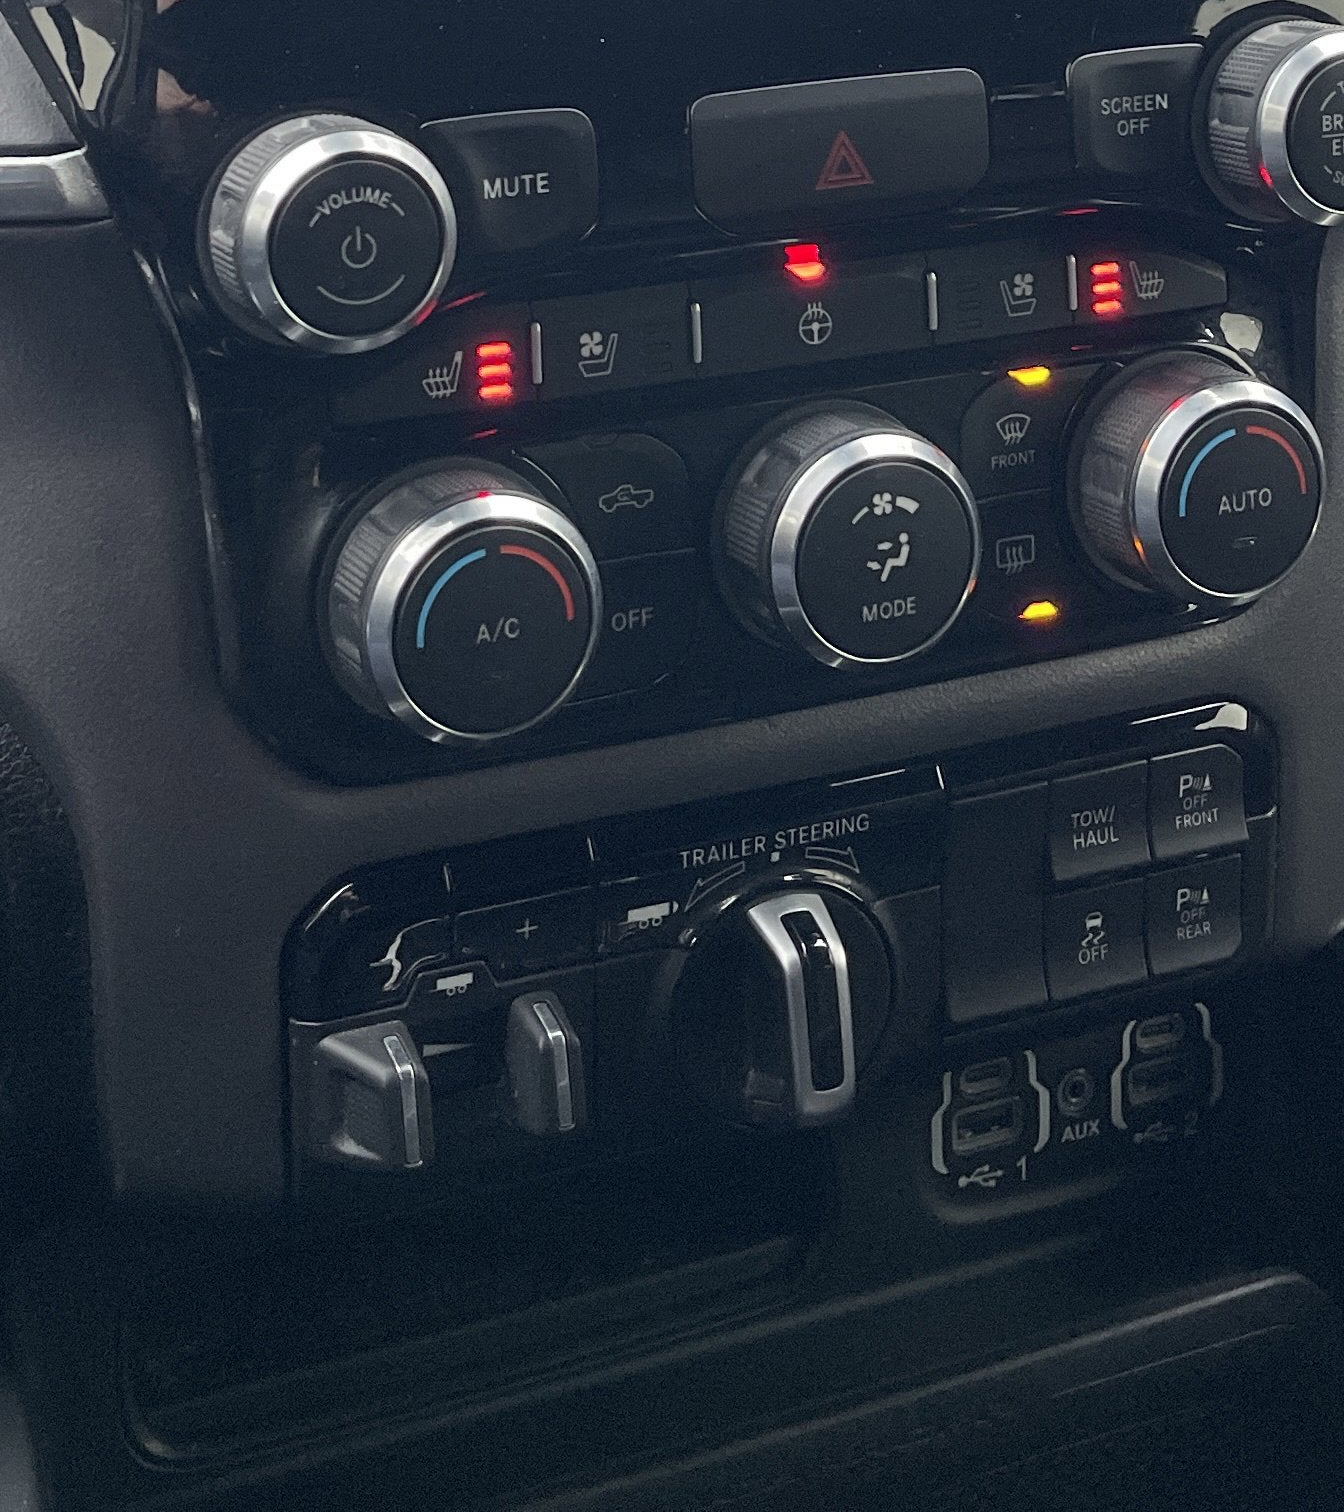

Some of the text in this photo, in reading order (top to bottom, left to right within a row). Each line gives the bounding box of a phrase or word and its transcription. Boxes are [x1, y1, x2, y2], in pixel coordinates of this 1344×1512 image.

[1100, 93, 1169, 117] SCREEN
[1116, 117, 1151, 138] OFF
[483, 172, 551, 200] MUTE
[316, 186, 393, 218] VOLUME
[990, 449, 1037, 470] FRONT
[1217, 487, 1273, 516] AUTO
[611, 606, 655, 632] OFF
[862, 596, 917, 623] MODE
[476, 617, 521, 643] A/C
[1182, 793, 1209, 811] OFF
[1071, 805, 1116, 827] TOW/
[1175, 807, 1220, 830] FRONT
[679, 813, 871, 871] TRAILER STEERING
[1072, 826, 1120, 850] HAUL
[1180, 906, 1206, 925] OFF
[1176, 921, 1212, 941] REAR
[1078, 944, 1109, 965] OFF
[1060, 1119, 1101, 1143] AUX
[1016, 1155, 1027, 1181] 1
